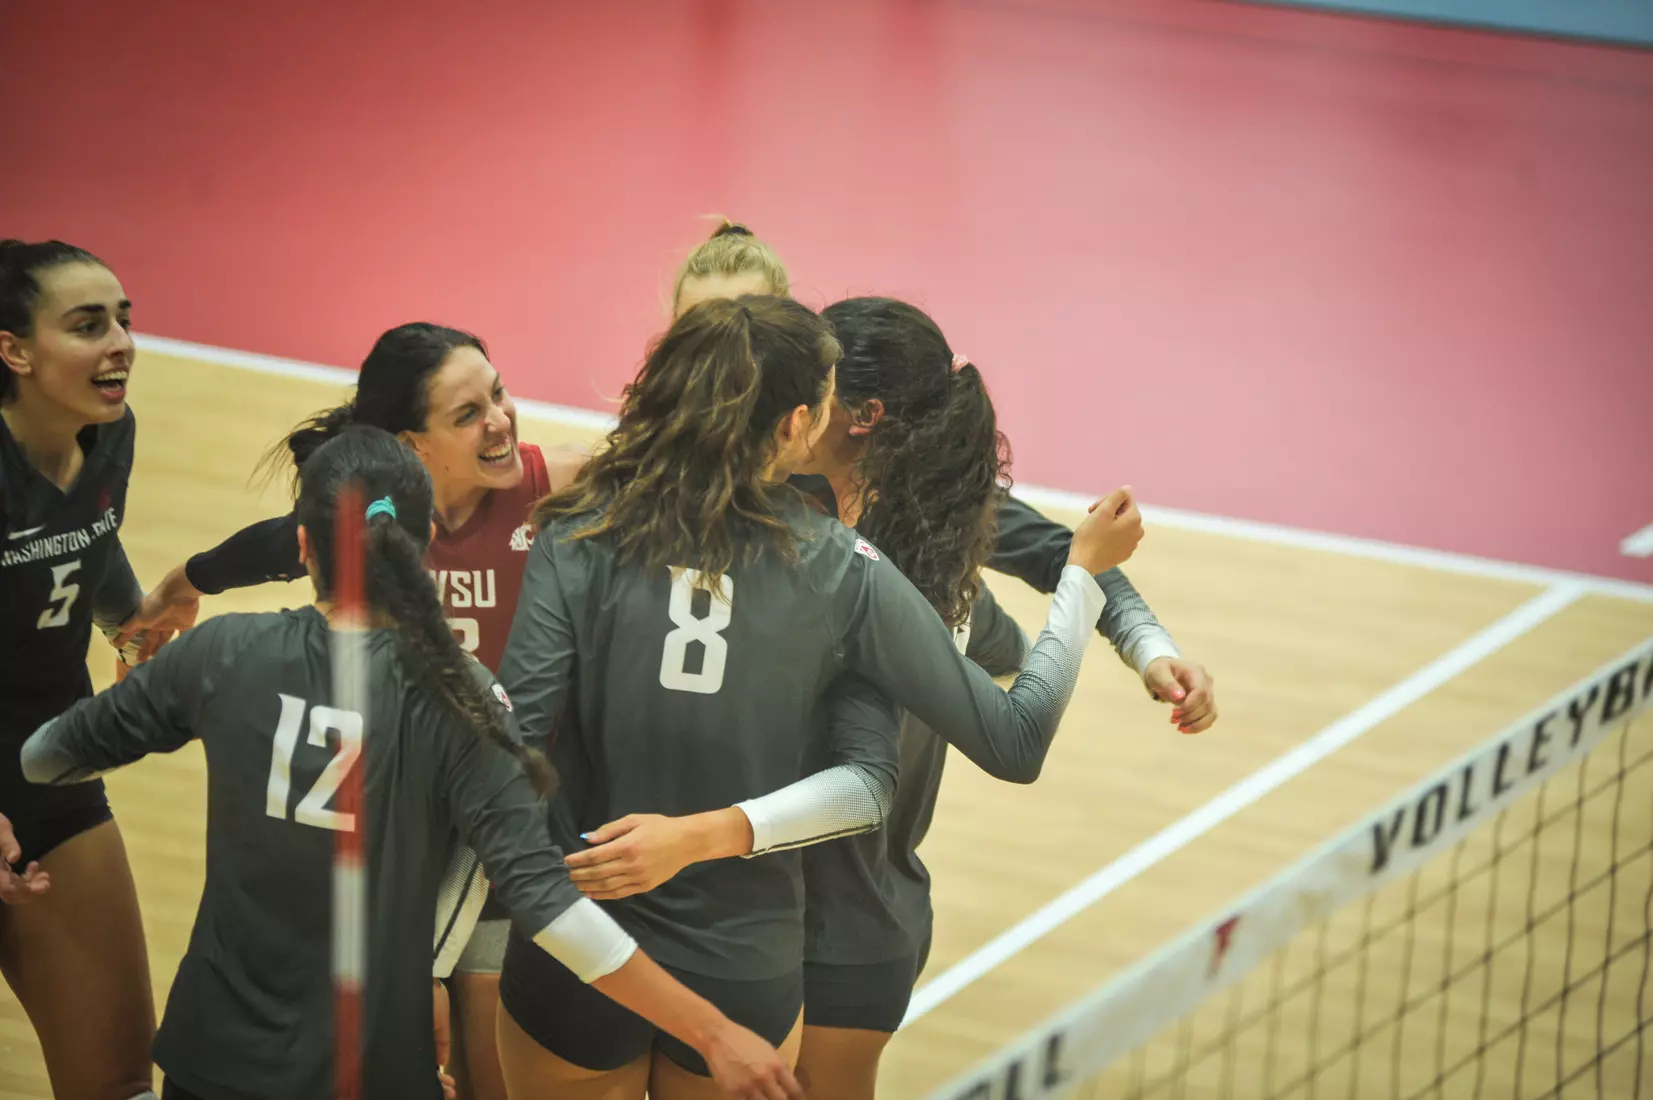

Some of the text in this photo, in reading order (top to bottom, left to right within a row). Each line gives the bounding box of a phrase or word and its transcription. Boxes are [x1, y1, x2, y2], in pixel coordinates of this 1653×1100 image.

[36, 558, 82, 630] 5
[659, 565, 734, 694] 8
[265, 693, 363, 832] 12
